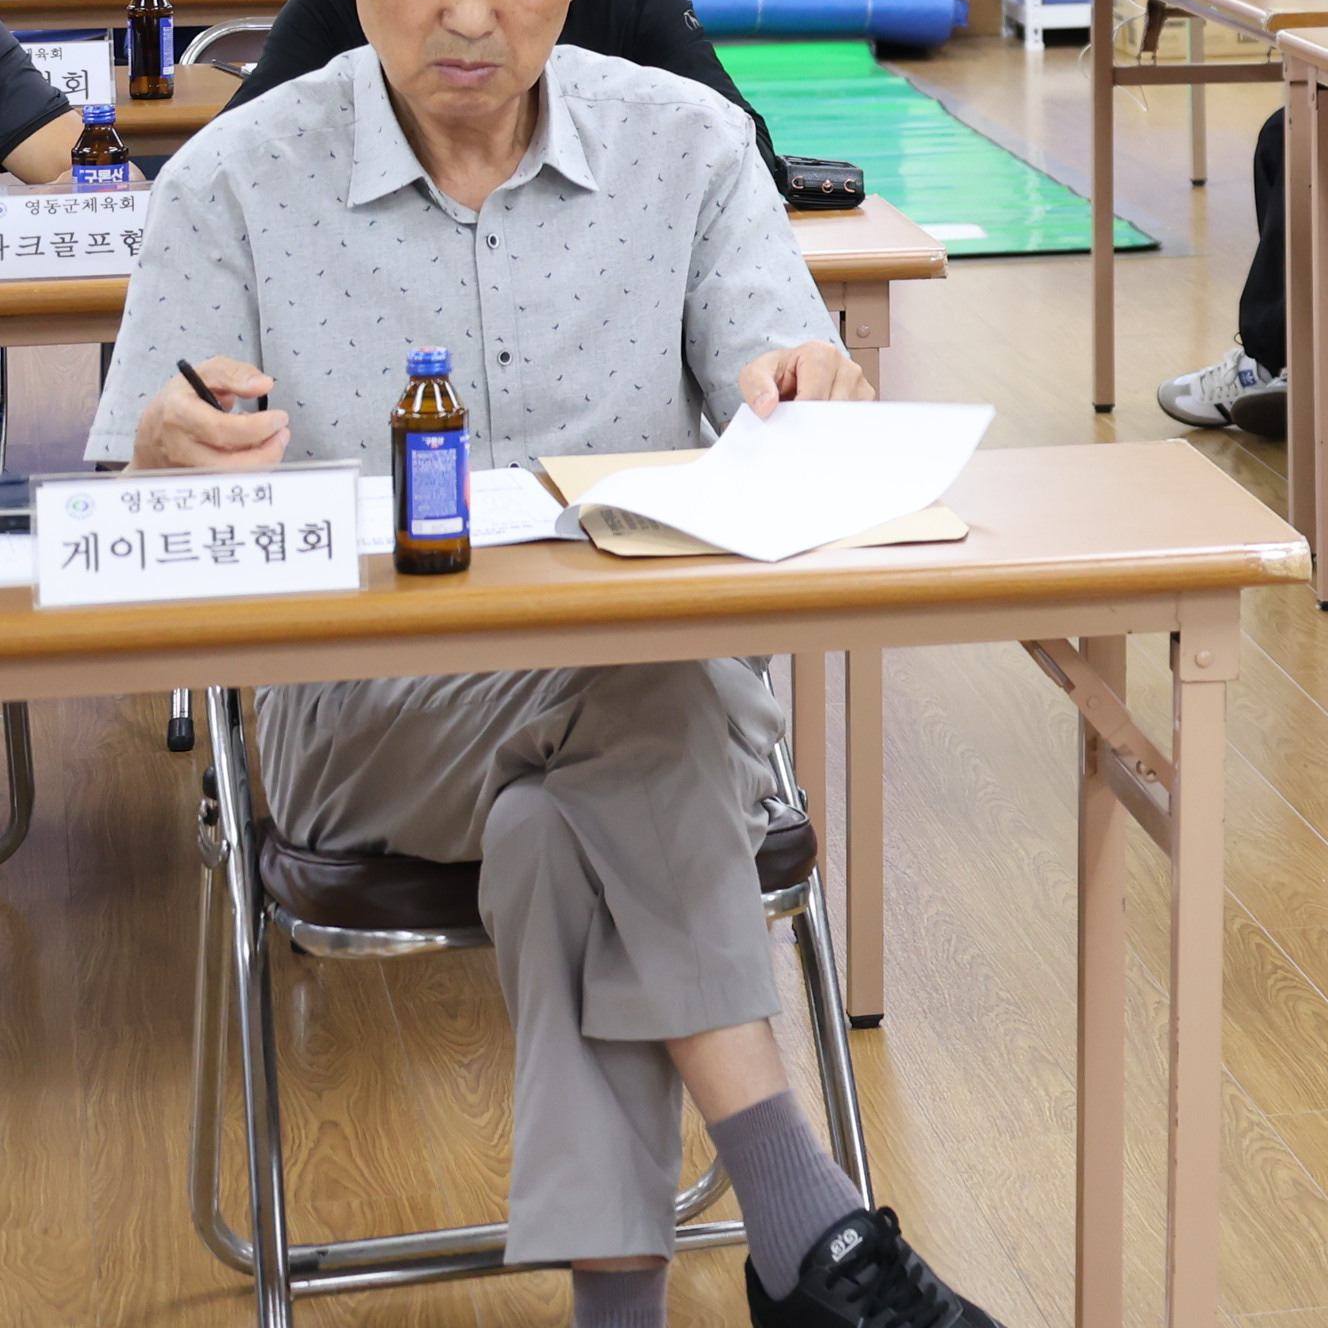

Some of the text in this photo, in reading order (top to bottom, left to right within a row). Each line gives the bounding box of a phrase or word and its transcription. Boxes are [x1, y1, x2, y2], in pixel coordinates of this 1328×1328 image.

[25, 195, 136, 215] 영동군체육회
[121, 483, 274, 513] 영동군체육회
[61, 519, 333, 572] 게이트볼협회
